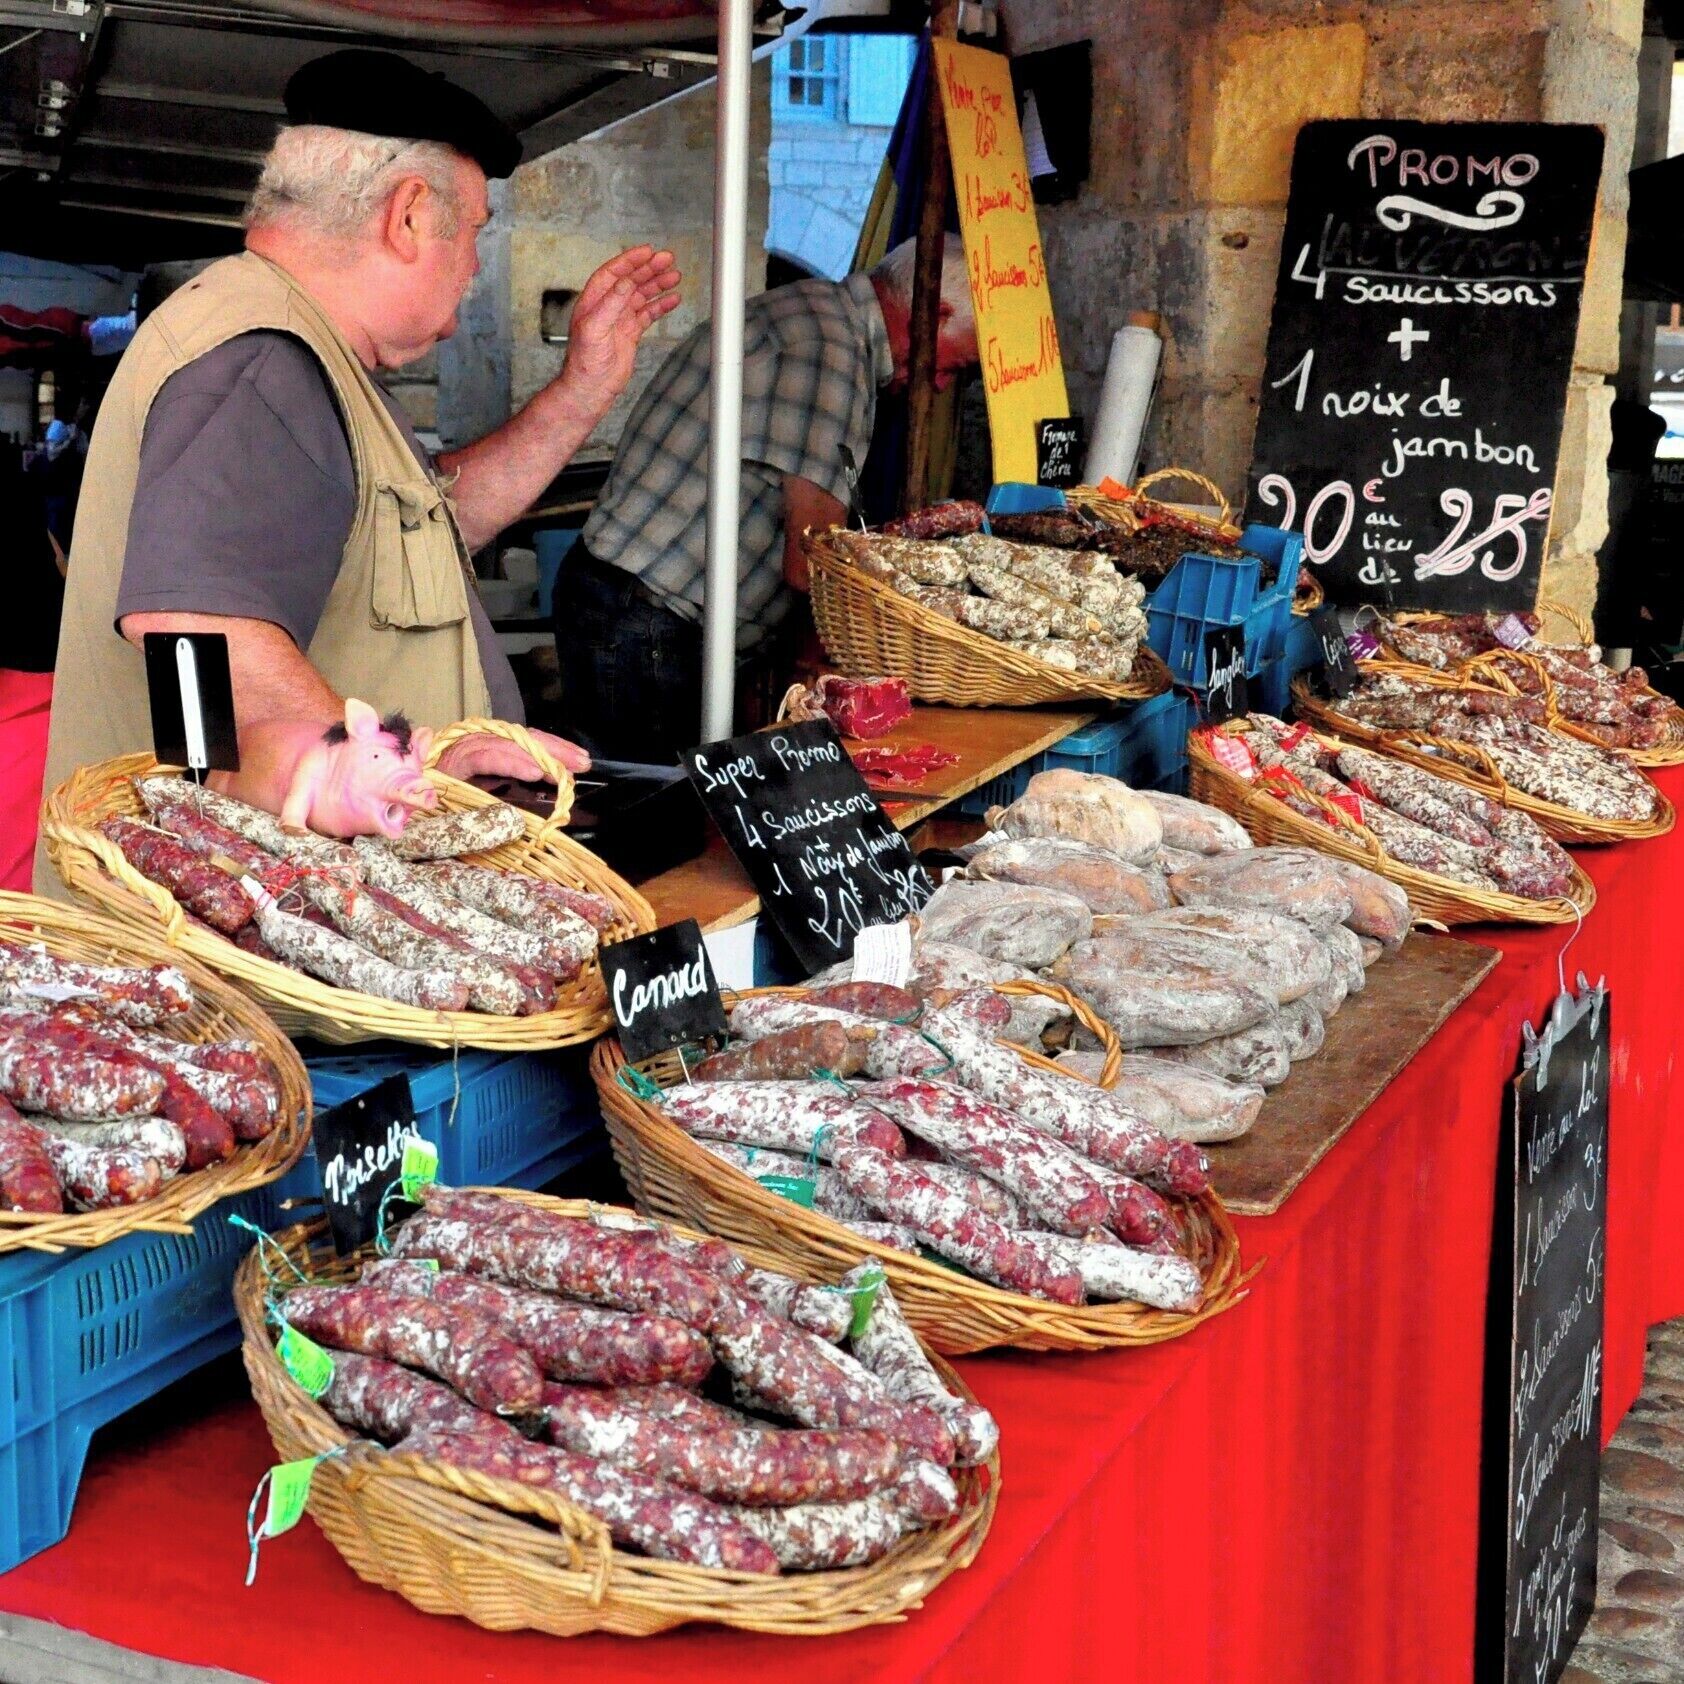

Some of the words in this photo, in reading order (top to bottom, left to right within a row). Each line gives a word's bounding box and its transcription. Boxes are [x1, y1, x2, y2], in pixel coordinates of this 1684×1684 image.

[1349, 134, 1540, 188] PROMO
[1291, 244, 1327, 300] 4
[1271, 349, 1315, 412] 1
[1322, 387, 1411, 417] noix
[1419, 378, 1462, 417] de
[1382, 428, 1540, 478] jambon
[1362, 532, 1413, 551] lieu
[1365, 511, 1401, 527] au
[1358, 556, 1401, 586] de
[695, 753, 766, 799] Super
[770, 736, 841, 773] Promo
[735, 804, 767, 849] 4
[761, 792, 877, 840] Saucissons
[846, 843, 866, 868] de
[613, 943, 708, 1027] Canard
